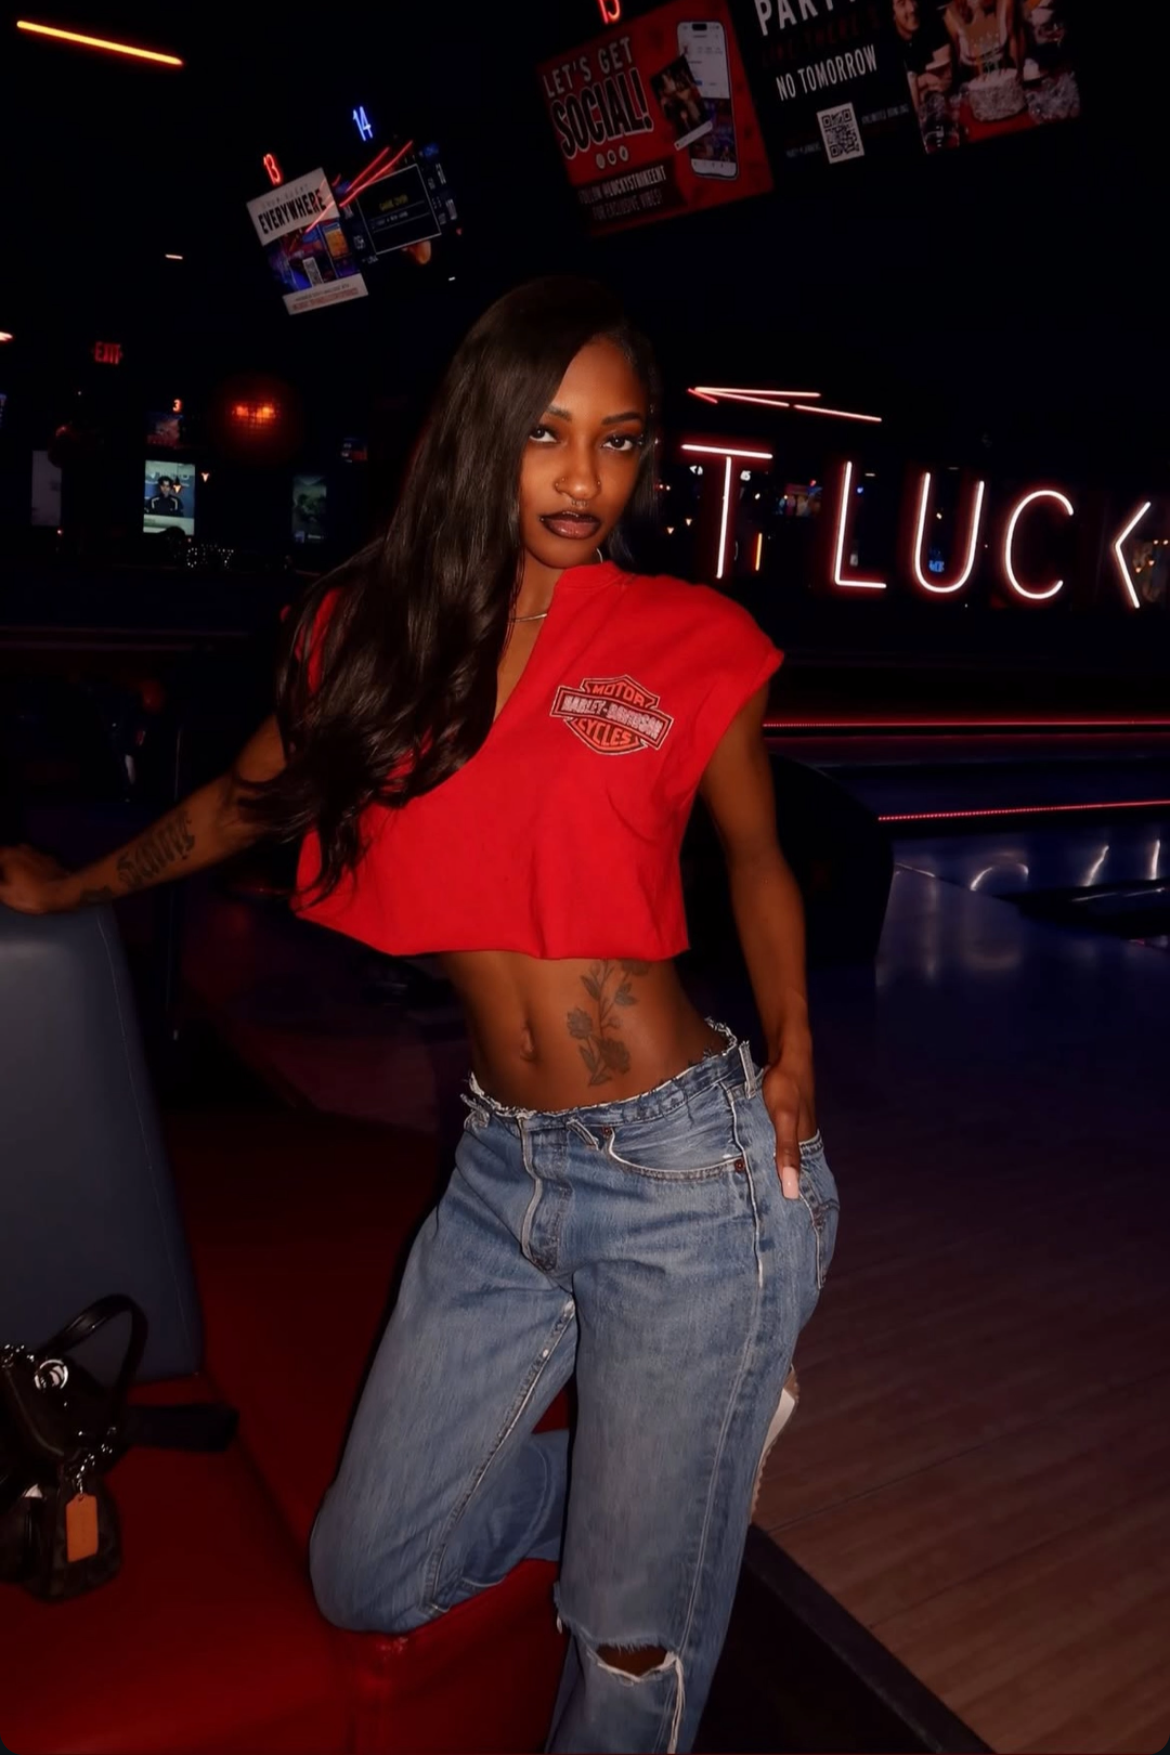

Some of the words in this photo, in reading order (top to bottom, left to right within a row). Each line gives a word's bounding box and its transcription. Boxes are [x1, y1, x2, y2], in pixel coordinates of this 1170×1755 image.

[543, 56, 593, 99] LET'S
[598, 36, 633, 75] GET
[775, 72, 797, 102] NO
[797, 43, 878, 95] TOMORROW
[353, 106, 374, 142] 14
[550, 66, 656, 160] SOCIAL!
[263, 153, 283, 186] 13
[258, 188, 328, 236] EVERYWHERE
[94, 342, 121, 365] EXIT
[833, 460, 1152, 610] LUCK
[591, 681, 645, 706] MOTOR
[577, 718, 633, 747] CYCLES
